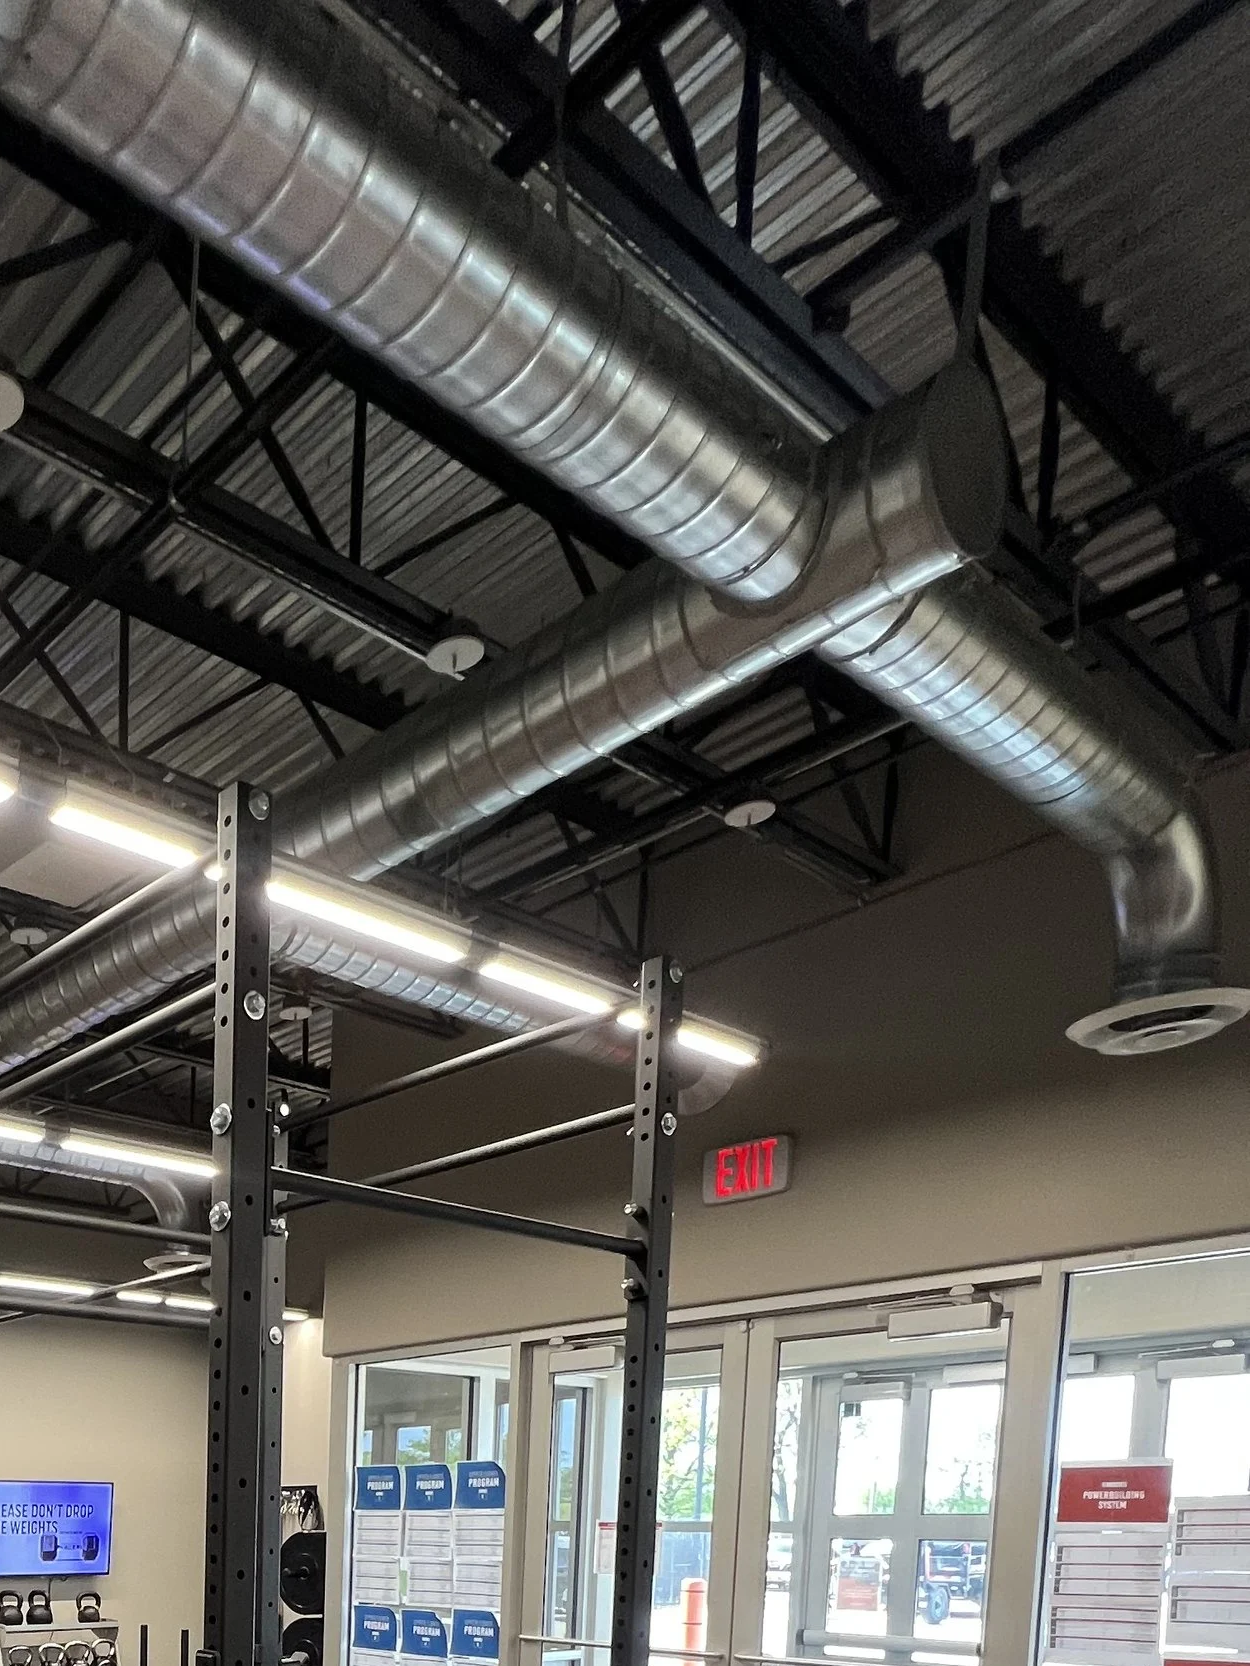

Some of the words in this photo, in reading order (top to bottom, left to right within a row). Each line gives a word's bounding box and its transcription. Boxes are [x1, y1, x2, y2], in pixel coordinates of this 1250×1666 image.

[716, 1138, 778, 1198] EXIT
[367, 1481, 394, 1490] PROGRAM
[416, 1480, 444, 1490] PROGRAM
[468, 1477, 499, 1487] PROGRAM
[1082, 1490, 1145, 1500] POWERBUILDING
[1098, 1500, 1127, 1509] SYSTEM
[31, 1504, 63, 1518] DON'T
[65, 1504, 94, 1518] DROP
[10, 1521, 58, 1534] WEIGHTS
[363, 1620, 390, 1631] PROGRAM
[412, 1625, 441, 1637] PROGRAM
[464, 1625, 495, 1637] PROGRAM
